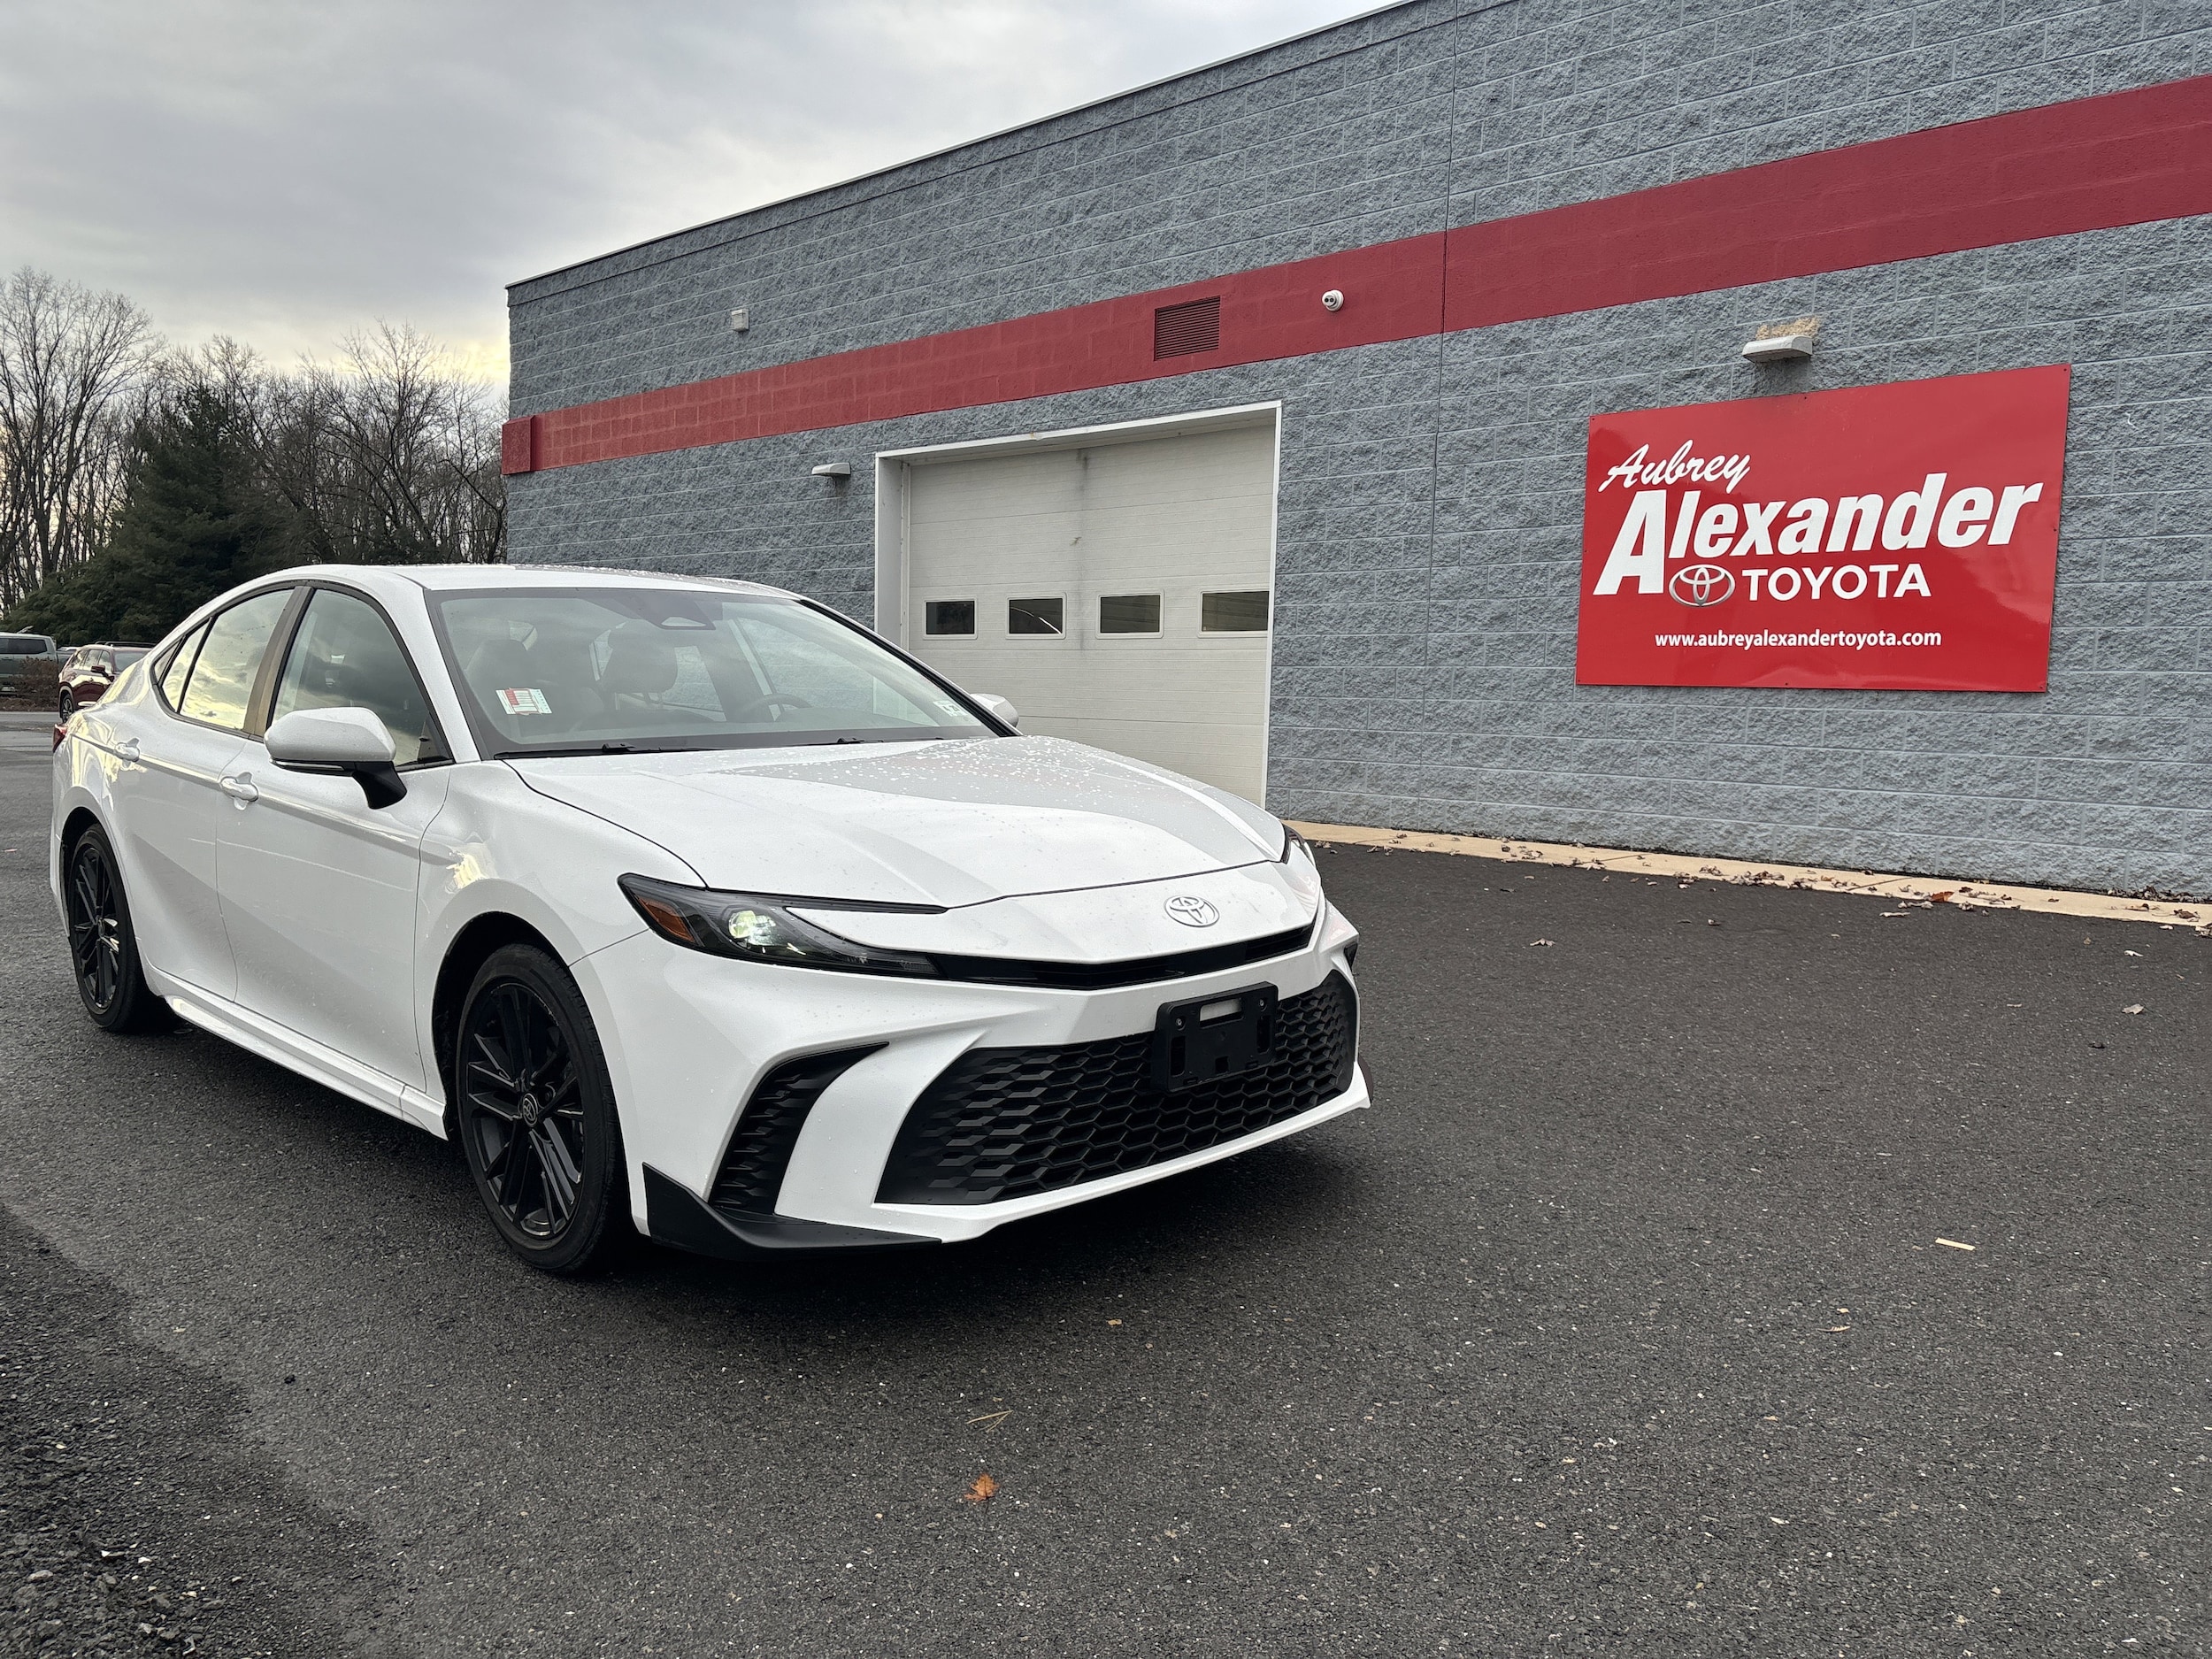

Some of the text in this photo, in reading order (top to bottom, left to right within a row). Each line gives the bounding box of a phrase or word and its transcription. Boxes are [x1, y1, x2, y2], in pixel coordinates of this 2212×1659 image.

[1598, 439, 1751, 494] Aubrey
[1593, 472, 2044, 595] Alexander
[1741, 563, 1932, 602] TOYOTA
[1655, 629, 1942, 651] www.aubreyalexandertoyota.com
